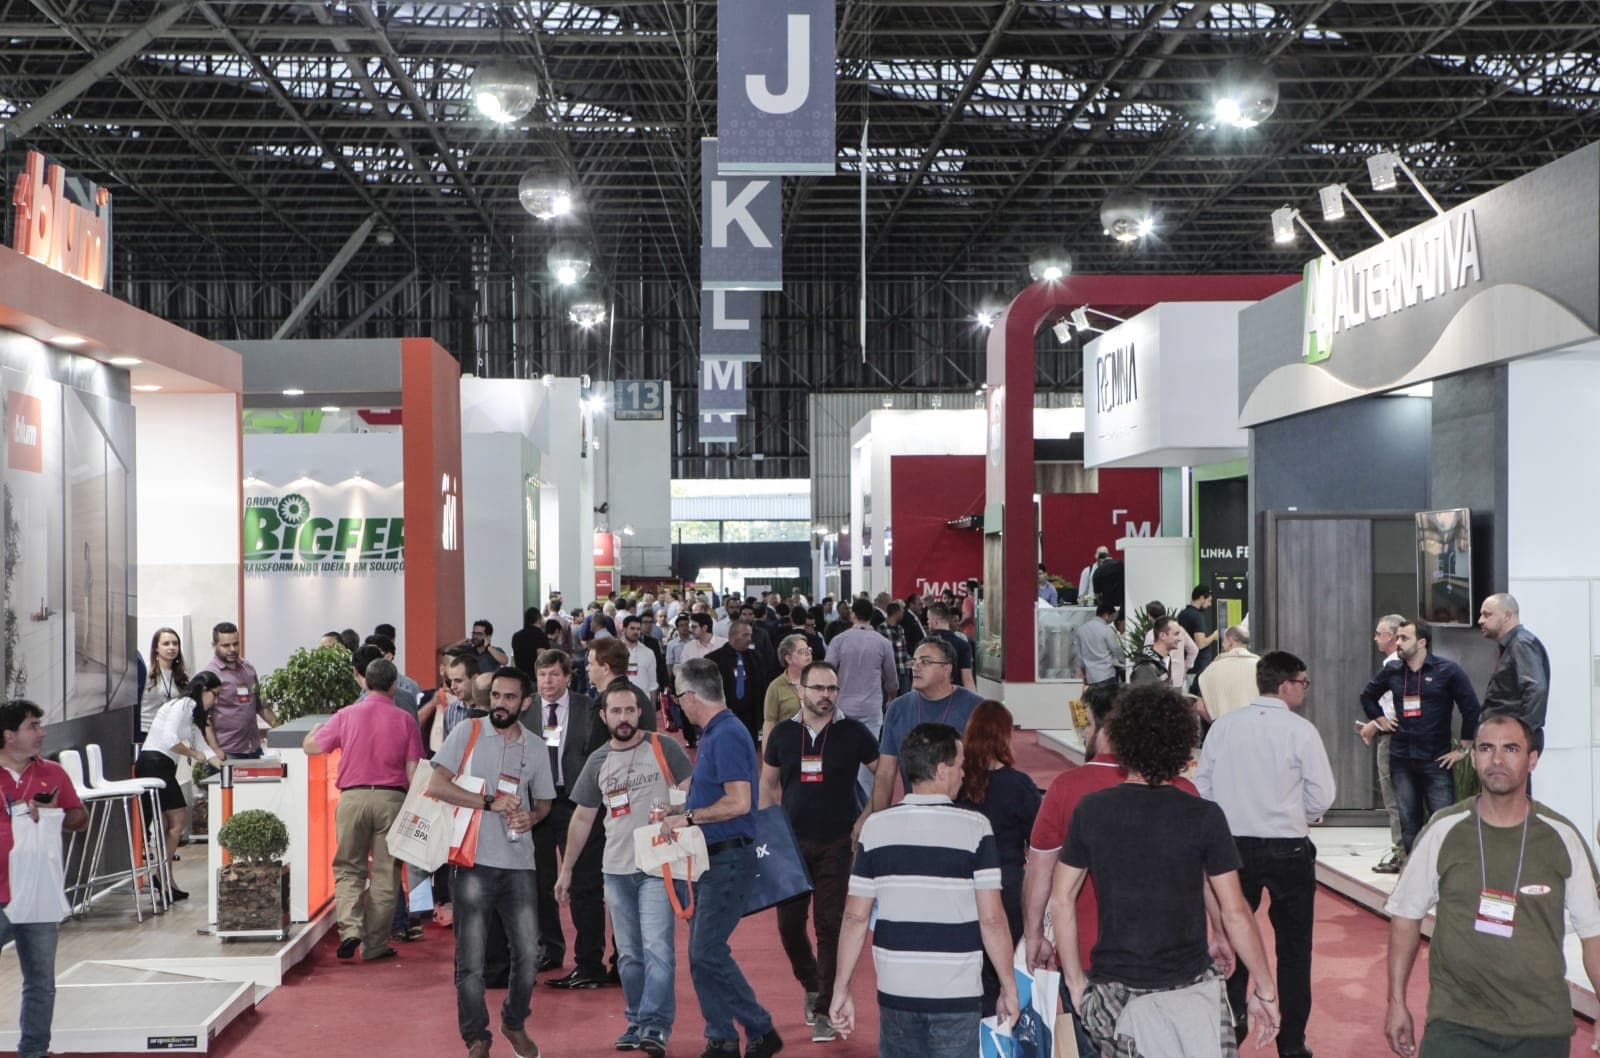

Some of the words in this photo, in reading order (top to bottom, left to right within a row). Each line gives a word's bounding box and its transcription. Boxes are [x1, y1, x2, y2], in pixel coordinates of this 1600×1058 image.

[745, 14, 810, 114] J
[26, 151, 106, 289] blum
[711, 181, 773, 247] K
[1335, 208, 1480, 333] ALTERNATIVA
[713, 290, 749, 330] L
[626, 382, 660, 409] 13
[703, 360, 743, 391] M
[246, 497, 278, 506] GRUPO
[1201, 548, 1232, 558] LINHA
